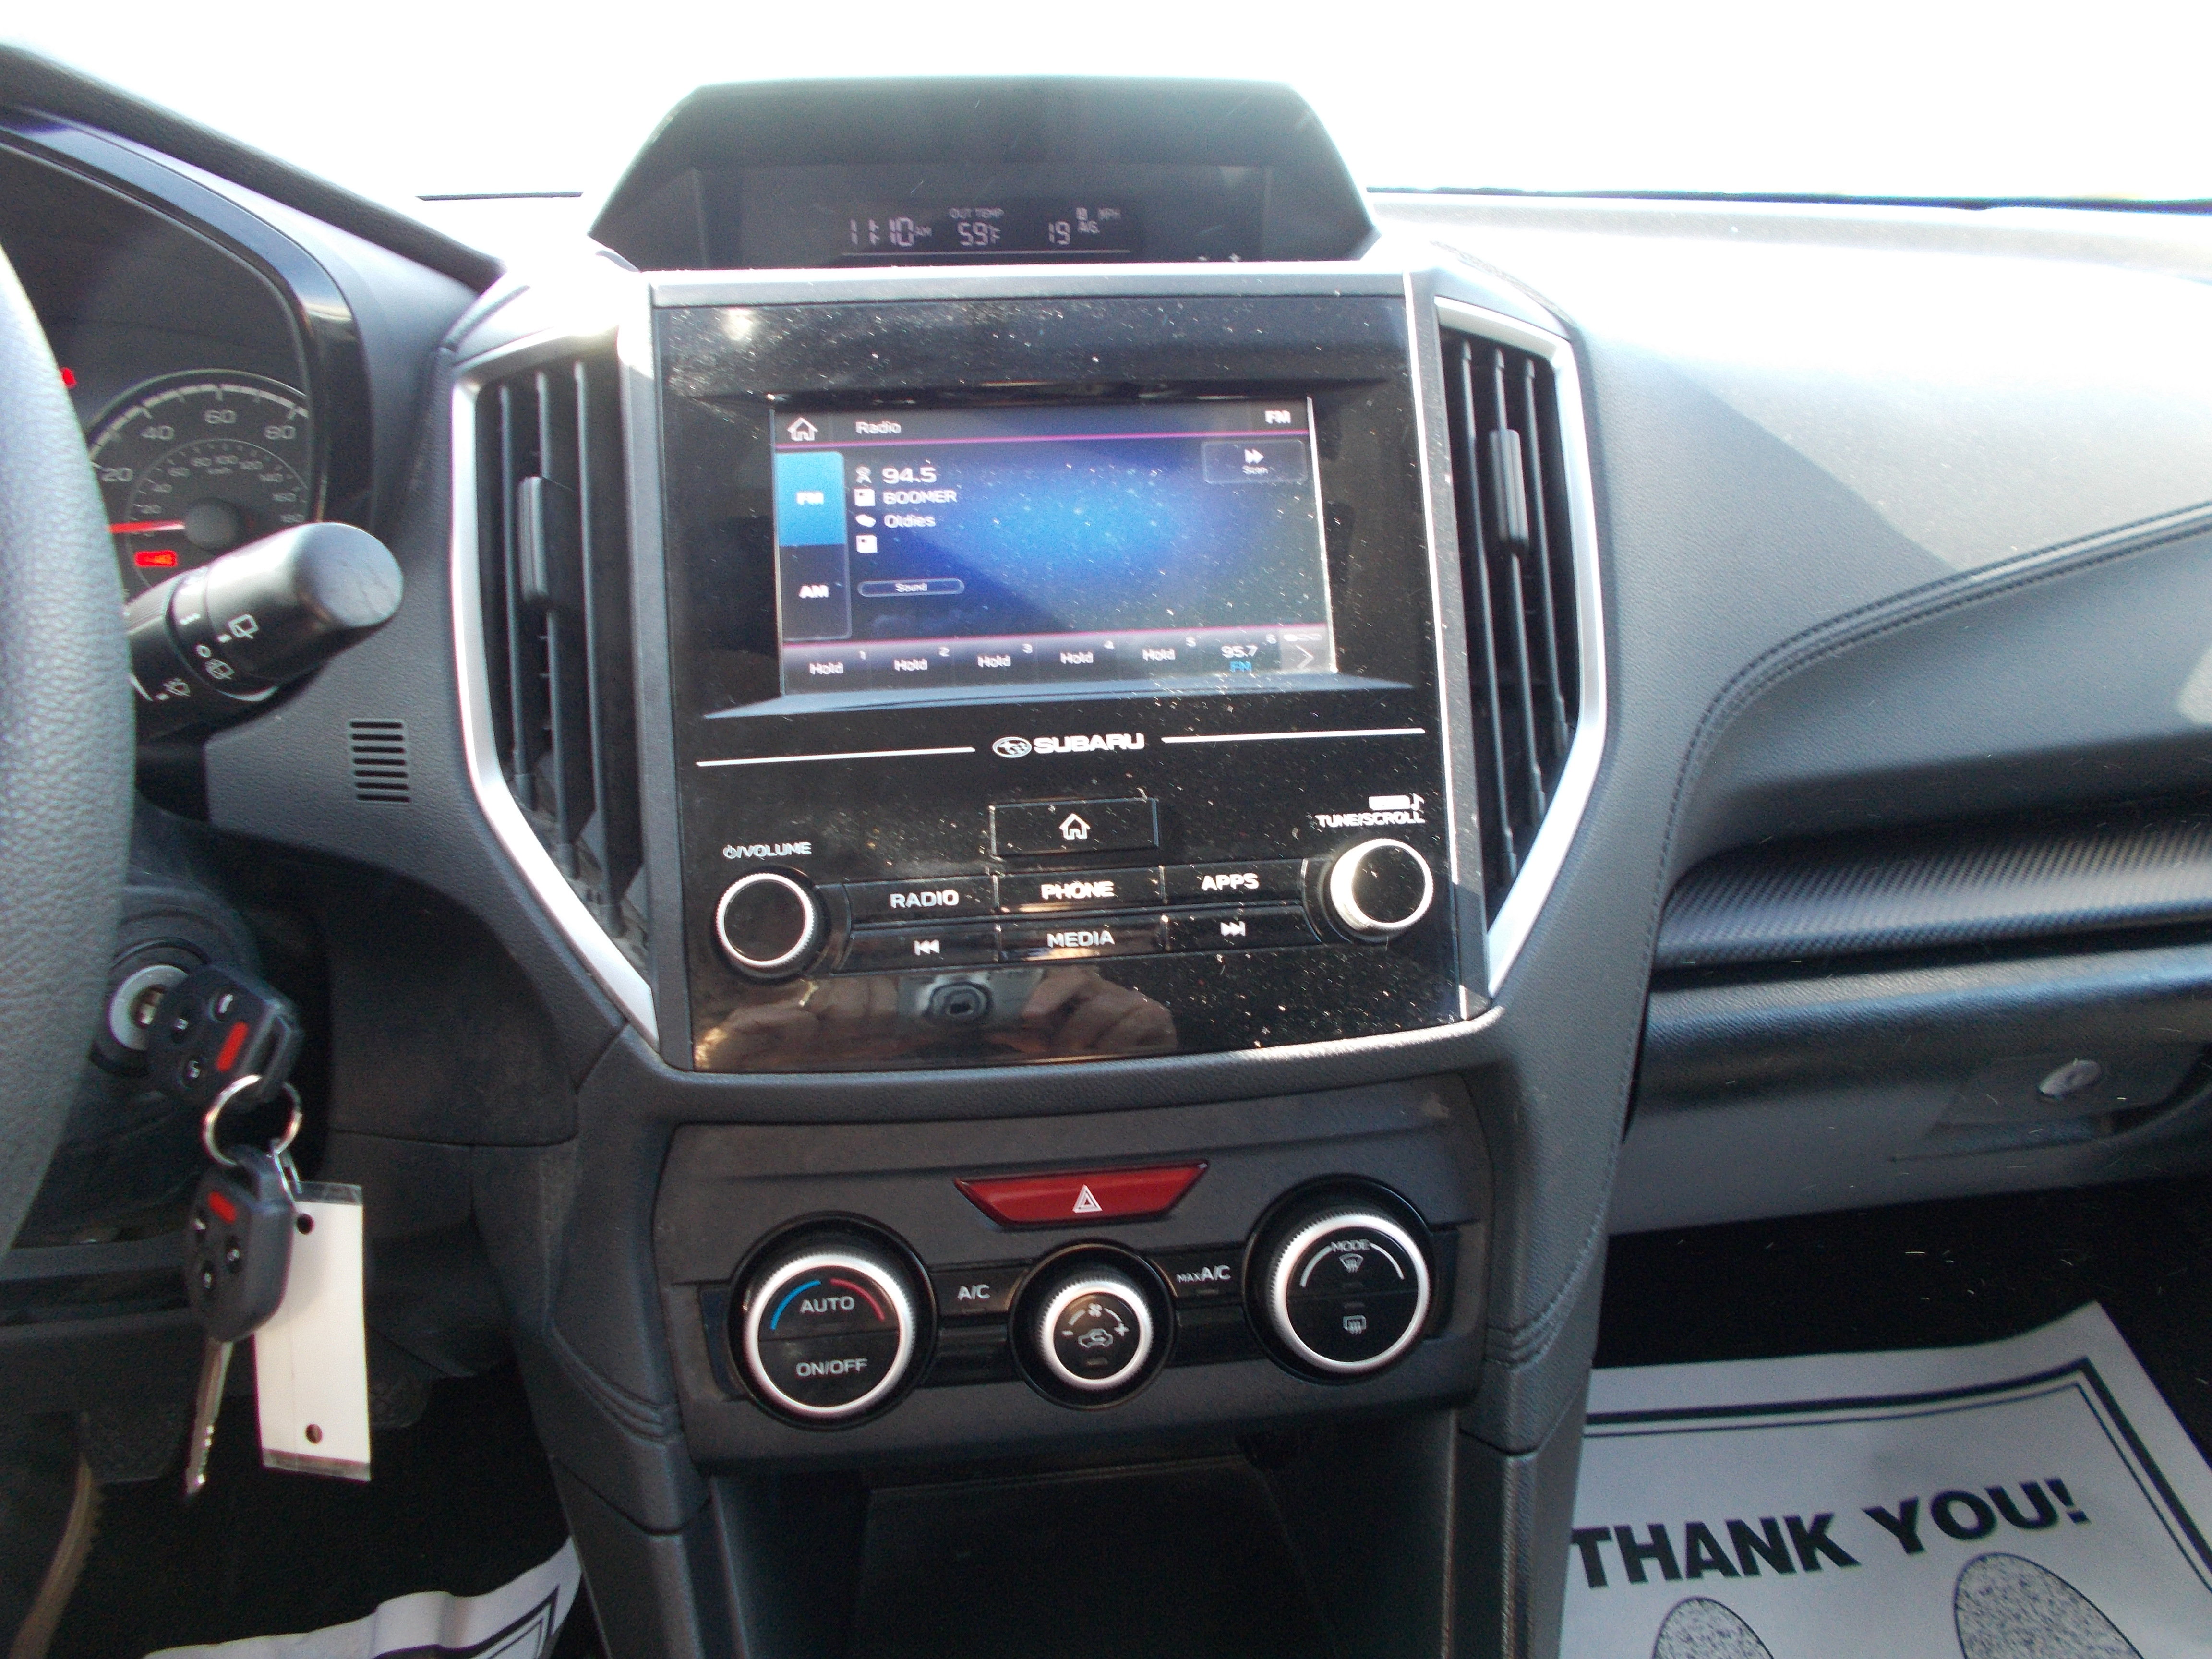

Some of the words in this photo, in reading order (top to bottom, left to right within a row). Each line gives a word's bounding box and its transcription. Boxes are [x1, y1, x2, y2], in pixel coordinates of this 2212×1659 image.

[204, 410, 236, 424] 60
[1265, 410, 1291, 424] FM
[143, 425, 174, 440] 40
[265, 425, 296, 440] 80
[856, 421, 902, 433] Radio
[102, 468, 133, 481] 20
[882, 467, 937, 484] 94.5
[884, 514, 936, 528] Oldies
[799, 585, 829, 598] AM
[895, 582, 928, 592] Sound
[1022, 643, 1033, 654] 3
[1142, 649, 1176, 661] Hold
[894, 658, 928, 671] Hold
[977, 655, 1011, 668] Hold
[1060, 651, 1094, 664] Hold
[810, 662, 843, 675] Hold
[1034, 733, 1144, 754] SUBARU
[1315, 811, 1426, 828] TUNE/SCROLL
[1201, 873, 1259, 891] APPS
[1041, 880, 1115, 901] PHONE
[890, 889, 959, 909] RADIO
[1046, 930, 1115, 948] MEDIA
[1331, 1238, 1371, 1253] MODE
[958, 1284, 990, 1300] A/C
[799, 1296, 855, 1314] AUTO
[795, 1358, 868, 1378] ON/OFF
[1572, 1512, 1860, 1588] THANK
[1862, 1477, 2091, 1555] YOU!
